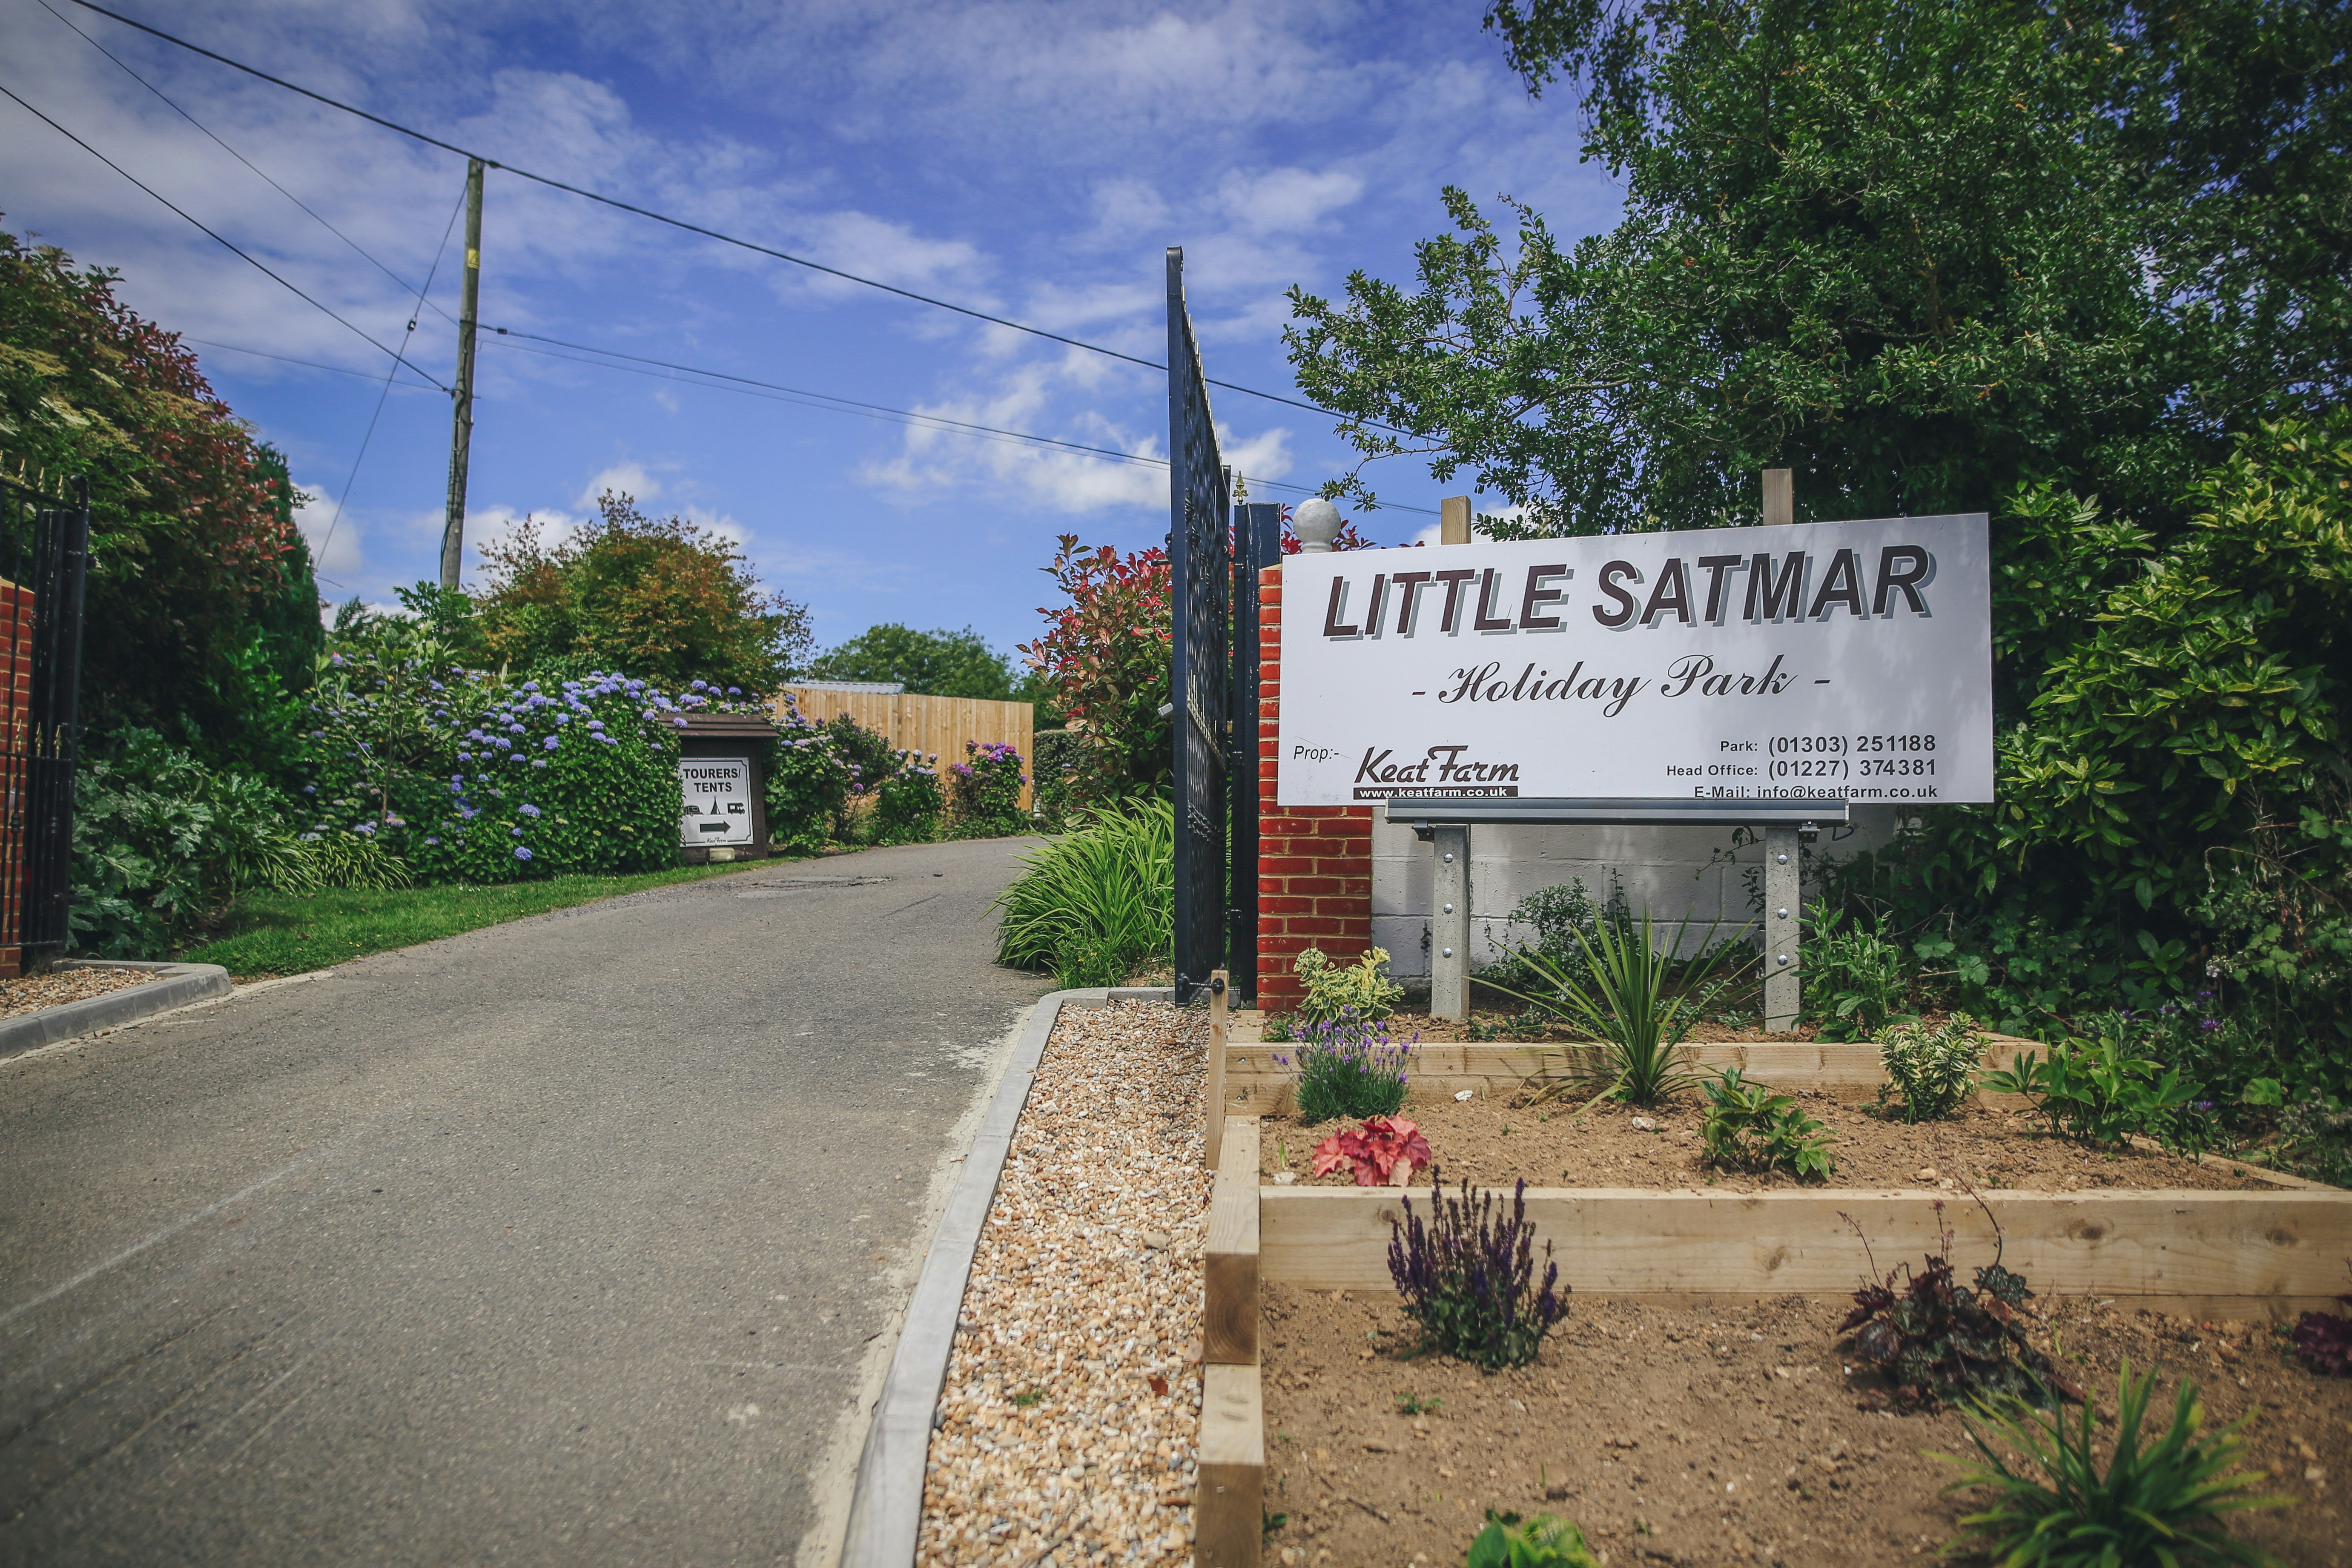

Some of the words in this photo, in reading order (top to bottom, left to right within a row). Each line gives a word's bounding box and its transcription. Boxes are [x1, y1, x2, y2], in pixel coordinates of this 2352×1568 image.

[1322, 564, 1574, 641] LITTLE
[1592, 545, 1937, 633] SATMAR
[1438, 661, 1652, 718] Holiday
[1661, 654, 1798, 697] Park
[1293, 745, 1339, 763] Prop:-
[1720, 740, 1758, 752] Park:
[1768, 736, 1848, 757] (01303)
[1856, 734, 1936, 752] 251188
[683, 768, 741, 780] TOURERS/
[1354, 746, 1430, 783] Keat
[1427, 745, 1520, 783] Farm
[1666, 765, 1702, 776] Head
[1708, 764, 1758, 776] Office:
[1768, 760, 1849, 781] (01227)
[1859, 759, 1935, 776] 374381
[694, 782, 732, 793] TENTS
[1359, 787, 1507, 798] www.keatfarm.co.uk
[1694, 785, 1751, 798] E-Mail:
[1757, 785, 1938, 799] info@keatfarm.co.uk
